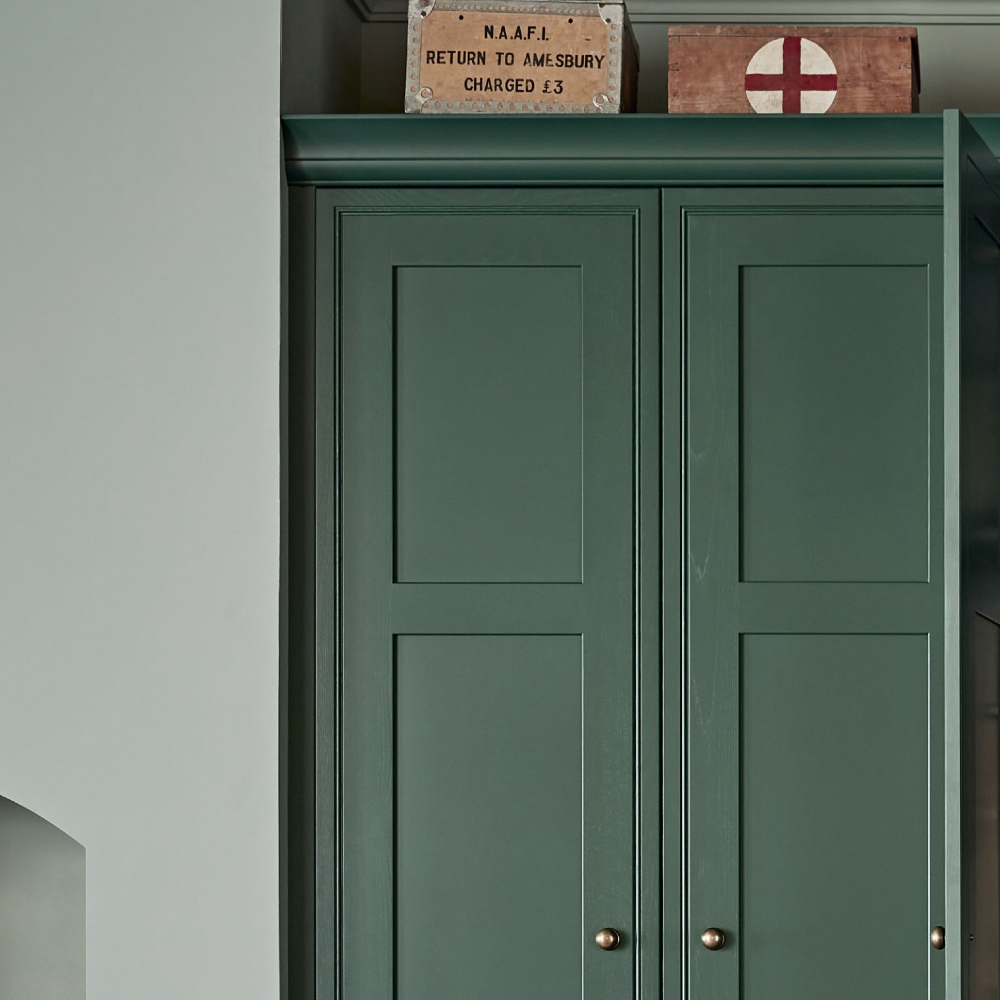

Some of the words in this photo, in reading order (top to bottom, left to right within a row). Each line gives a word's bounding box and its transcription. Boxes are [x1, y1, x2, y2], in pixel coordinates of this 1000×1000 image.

[484, 25, 549, 41] N.A.A.F.I.
[426, 50, 486, 66] RETURN
[495, 52, 515, 66] TO
[523, 53, 605, 69] AMESBURY
[464, 77, 535, 93] CHARGED
[542, 79, 564, 94] £3
